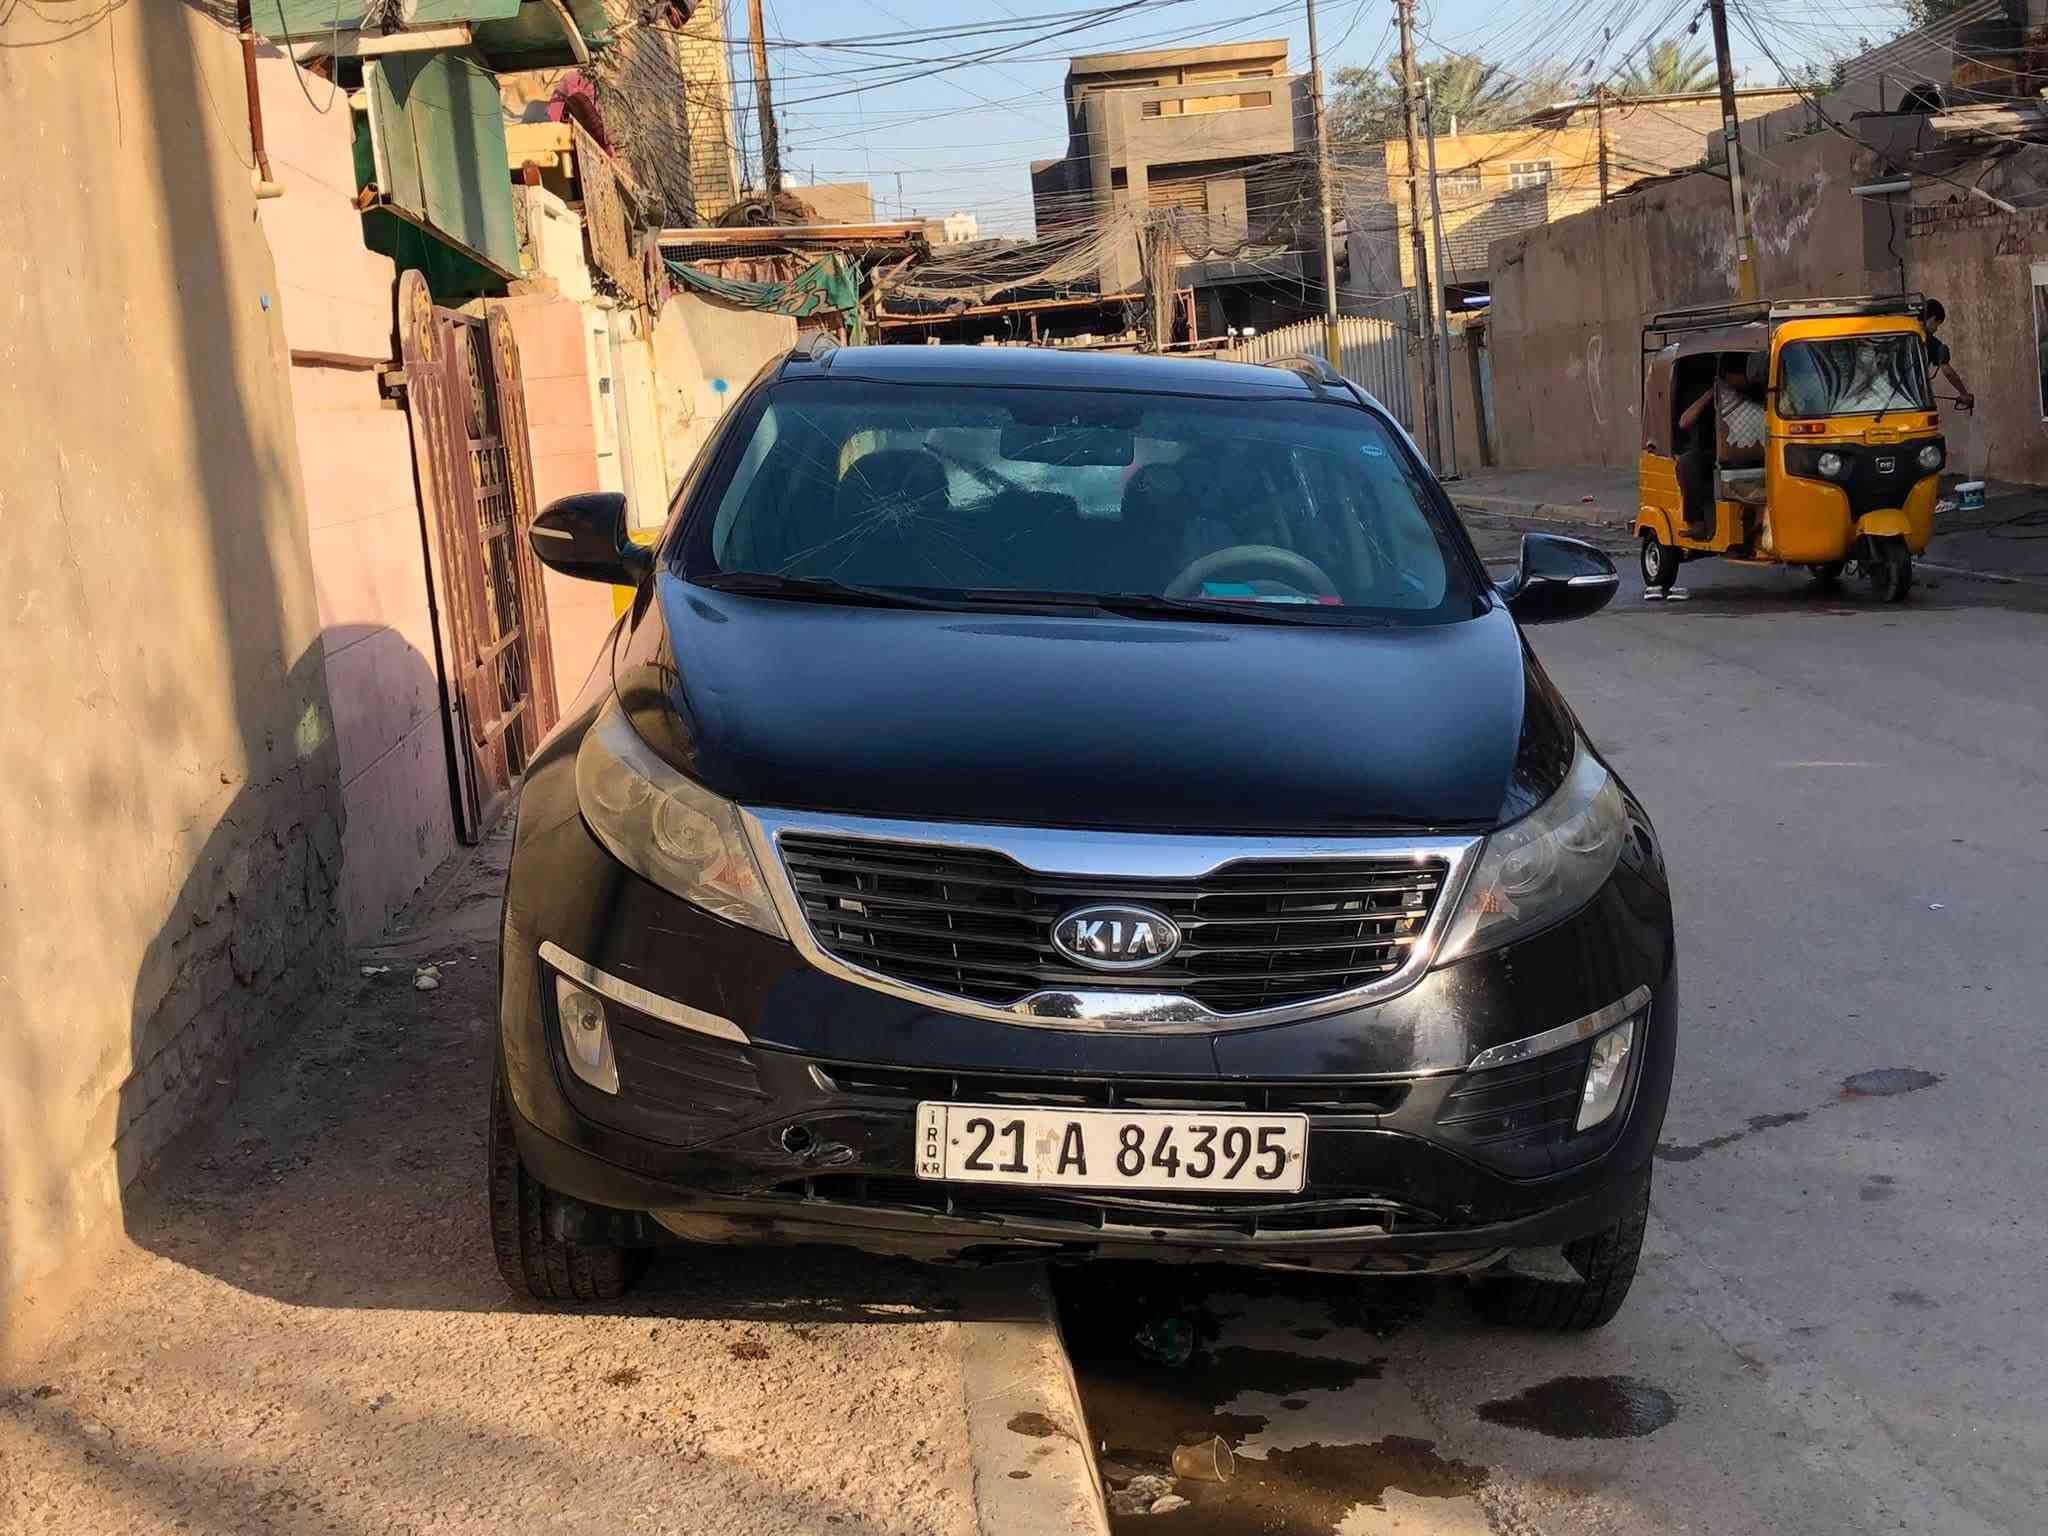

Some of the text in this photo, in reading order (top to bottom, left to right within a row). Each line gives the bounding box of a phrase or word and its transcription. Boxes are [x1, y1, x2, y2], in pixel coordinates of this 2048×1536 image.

[1075, 919, 1158, 954] KIA
[964, 1117, 1287, 1180] 21 A 84395
